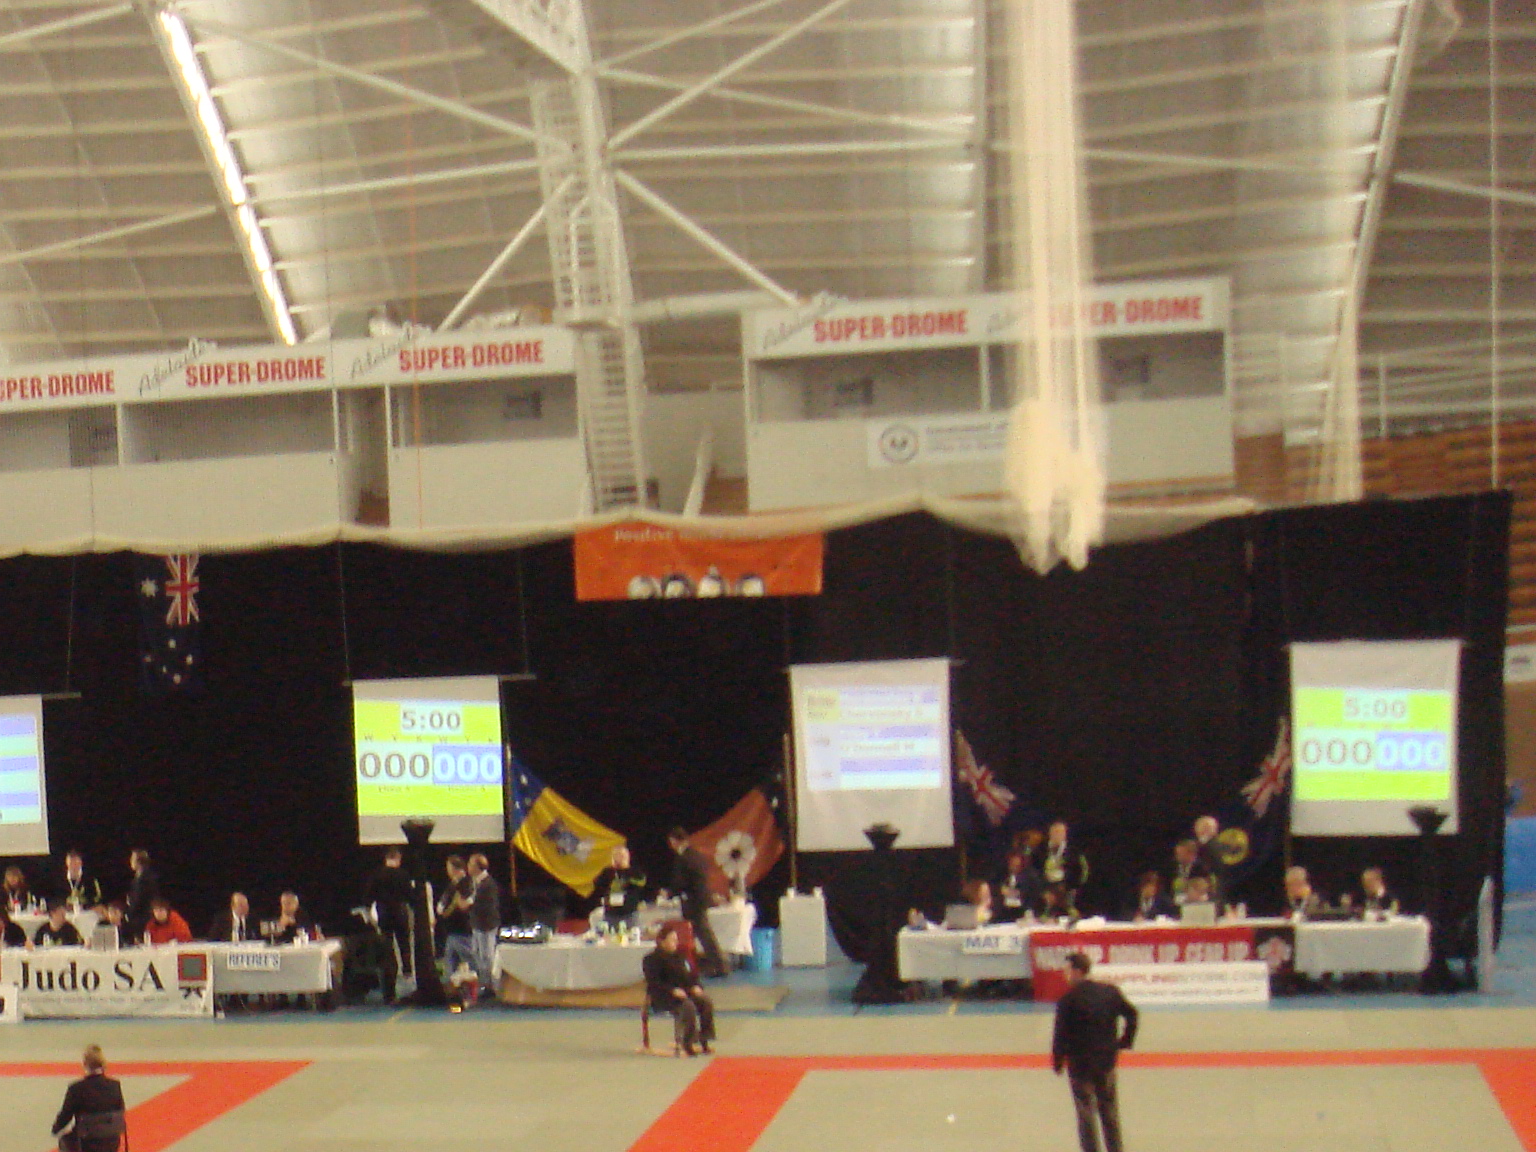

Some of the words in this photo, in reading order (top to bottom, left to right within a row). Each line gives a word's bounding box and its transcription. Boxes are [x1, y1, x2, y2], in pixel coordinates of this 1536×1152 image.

[1345, 698, 1406, 719] 5:00
[402, 710, 462, 730] 5:00
[20, 960, 101, 992] Judo
[114, 959, 166, 992] SA
